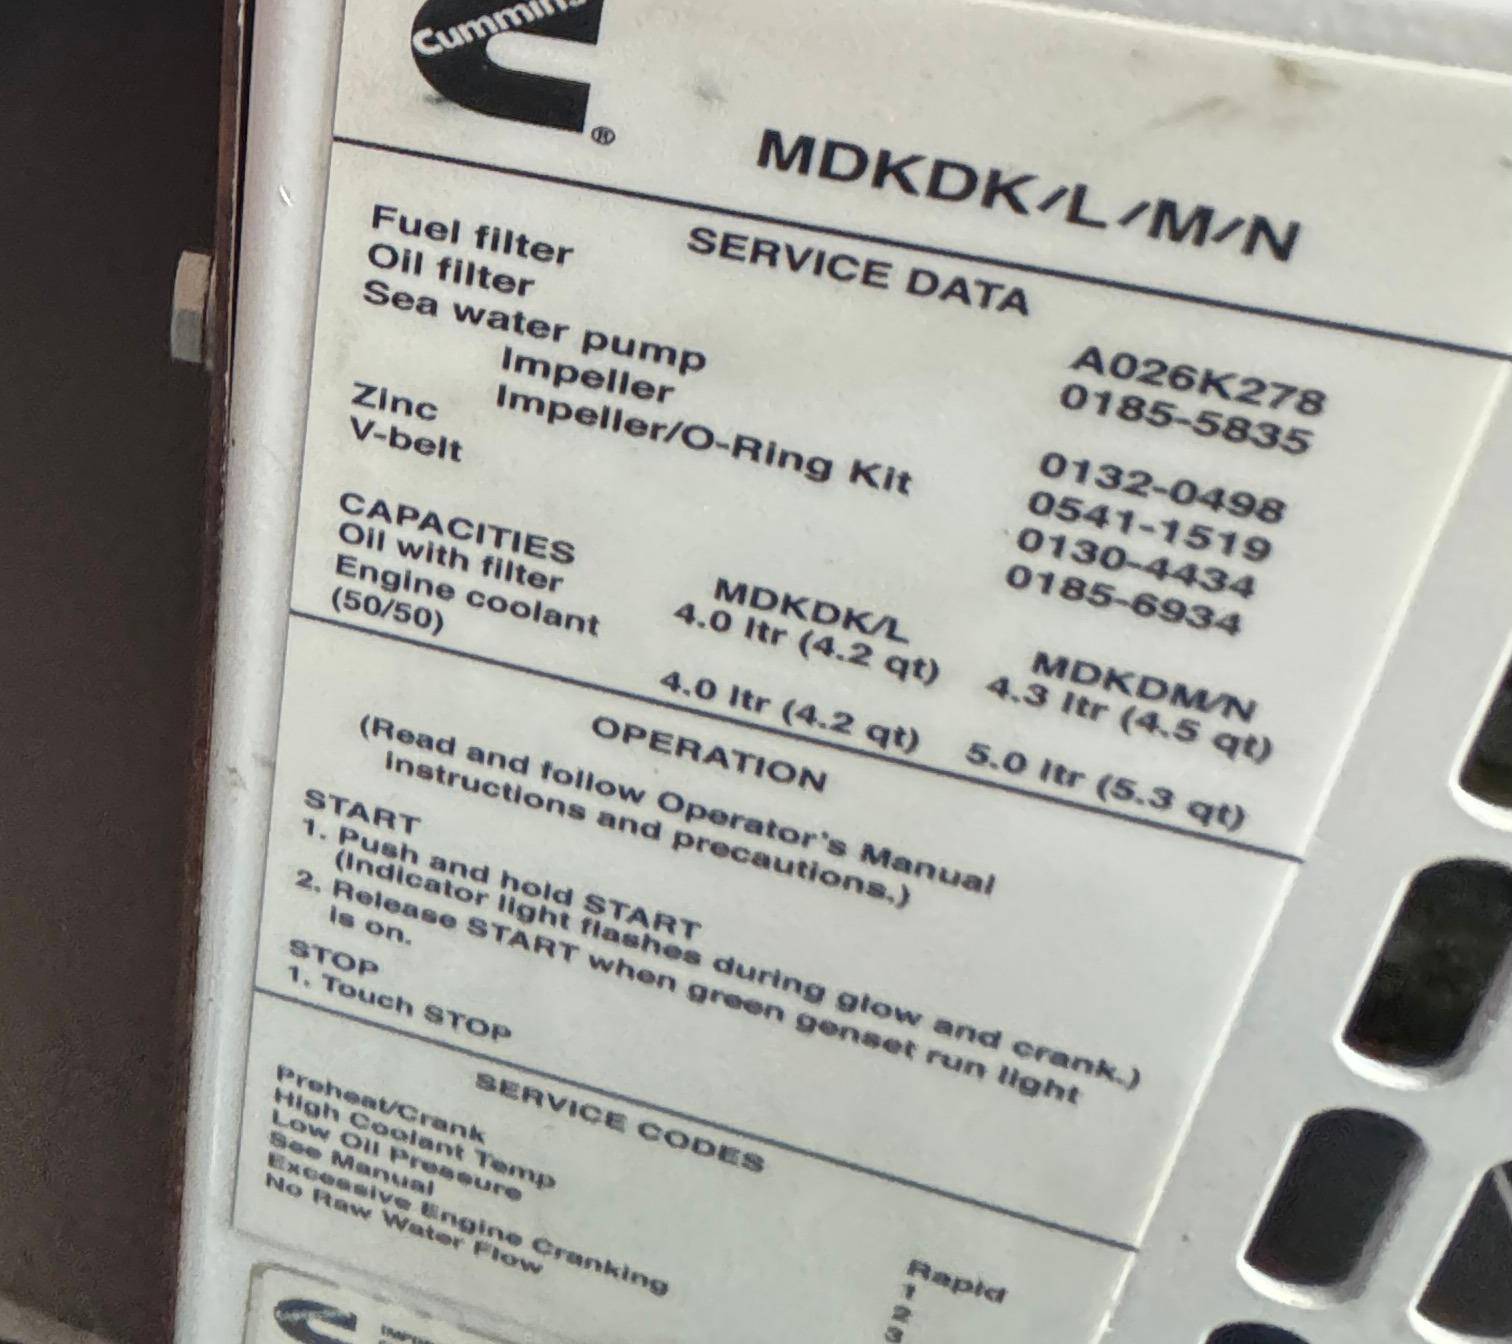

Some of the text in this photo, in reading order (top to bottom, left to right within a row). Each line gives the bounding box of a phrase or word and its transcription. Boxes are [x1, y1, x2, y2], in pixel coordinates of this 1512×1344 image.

[756, 128, 1301, 262] MDKDK/L/M/N
[368, 244, 535, 298] Oil filter
[372, 204, 574, 266] Fuel filter
[687, 227, 1031, 316] SERVICE DATA
[363, 280, 707, 376] Sea water pump
[352, 381, 438, 422] Zinc
[502, 347, 675, 405] Impeller
[1069, 346, 1327, 416] A026K278
[350, 417, 463, 463] V-belt
[496, 384, 913, 496] Impeller/O-Ring Kit
[1059, 383, 1315, 455] 0185-5835
[1039, 452, 1286, 524] 0132-0498
[339, 492, 576, 564] CAPACITIES
[339, 522, 564, 594] Oil with filter
[1017, 527, 1255, 600] 0130-4434
[1028, 492, 1272, 562] 0541-1519
[331, 586, 444, 636] (50/50)
[334, 554, 600, 637] Engine coolant
[713, 577, 911, 644] MDKDK/L
[1005, 564, 1242, 636] 0185-6934
[673, 603, 941, 687] 4.0 ltr (4.2 qt)
[660, 670, 921, 755] 4.0 ltr (4.2 qt)
[985, 676, 1273, 764] 4.3 ltr (4.5 qt)
[1031, 651, 1259, 723] MDKDM/N
[592, 716, 827, 793] OPERATION
[965, 741, 1248, 833] 5.0 ltr (5.3 qt)
[303, 788, 422, 835] START
[359, 714, 996, 895] (Read and follow Operator's Manual
[302, 817, 702, 940] 1. Push and hold START
[596, 811, 662, 840] and
[672, 830, 912, 909] precautions.)
[289, 938, 380, 976] STOP
[365, 920, 413, 945] on.
[287, 964, 512, 1042] 1. Touch STOP
[295, 869, 1083, 1106] 2. Release START when green genset run light
[335, 849, 1142, 1092] (Indicator light flashes during glow and crank.)
[273, 1085, 557, 1192] High Coolant Temp
[276, 1063, 487, 1145] Preheat/Crank
[475, 1071, 766, 1175] SERVICE CODES
[268, 1129, 436, 1198] See Manual
[271, 1108, 523, 1202] Low Oil Pressure
[265, 1172, 544, 1276] No Raw Water Flow
[266, 1150, 670, 1298] Excessive Engine Cranking
[891, 1305, 912, 1323] 2
[903, 1283, 916, 1301] 1
[906, 1259, 1008, 1303] Rapid
